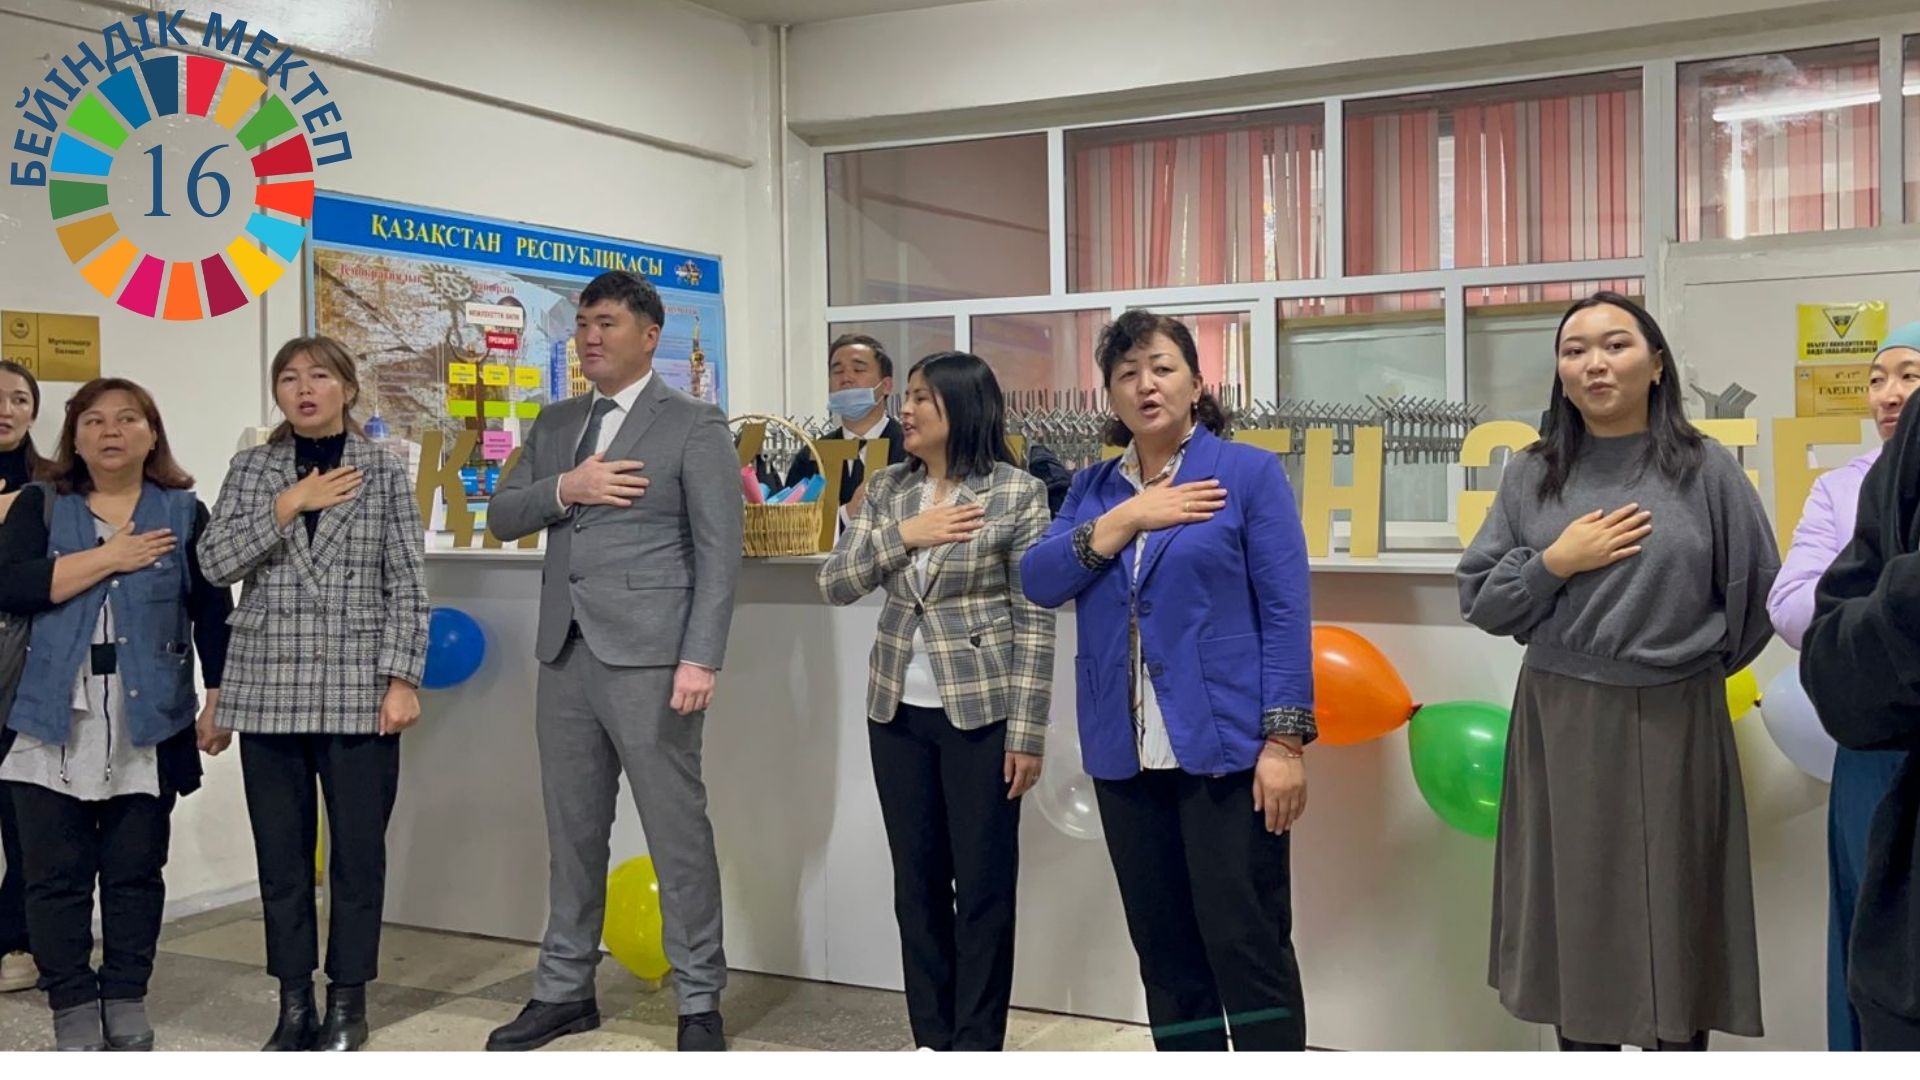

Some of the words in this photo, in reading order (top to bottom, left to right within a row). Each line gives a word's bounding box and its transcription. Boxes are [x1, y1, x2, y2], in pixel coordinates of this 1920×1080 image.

[371, 213, 501, 253] ҚАЗАҚСТАН
[516, 236, 664, 277] РЕСПУБЛИКАСЫ
[1819, 386, 1870, 395] ГАРДЕРО
